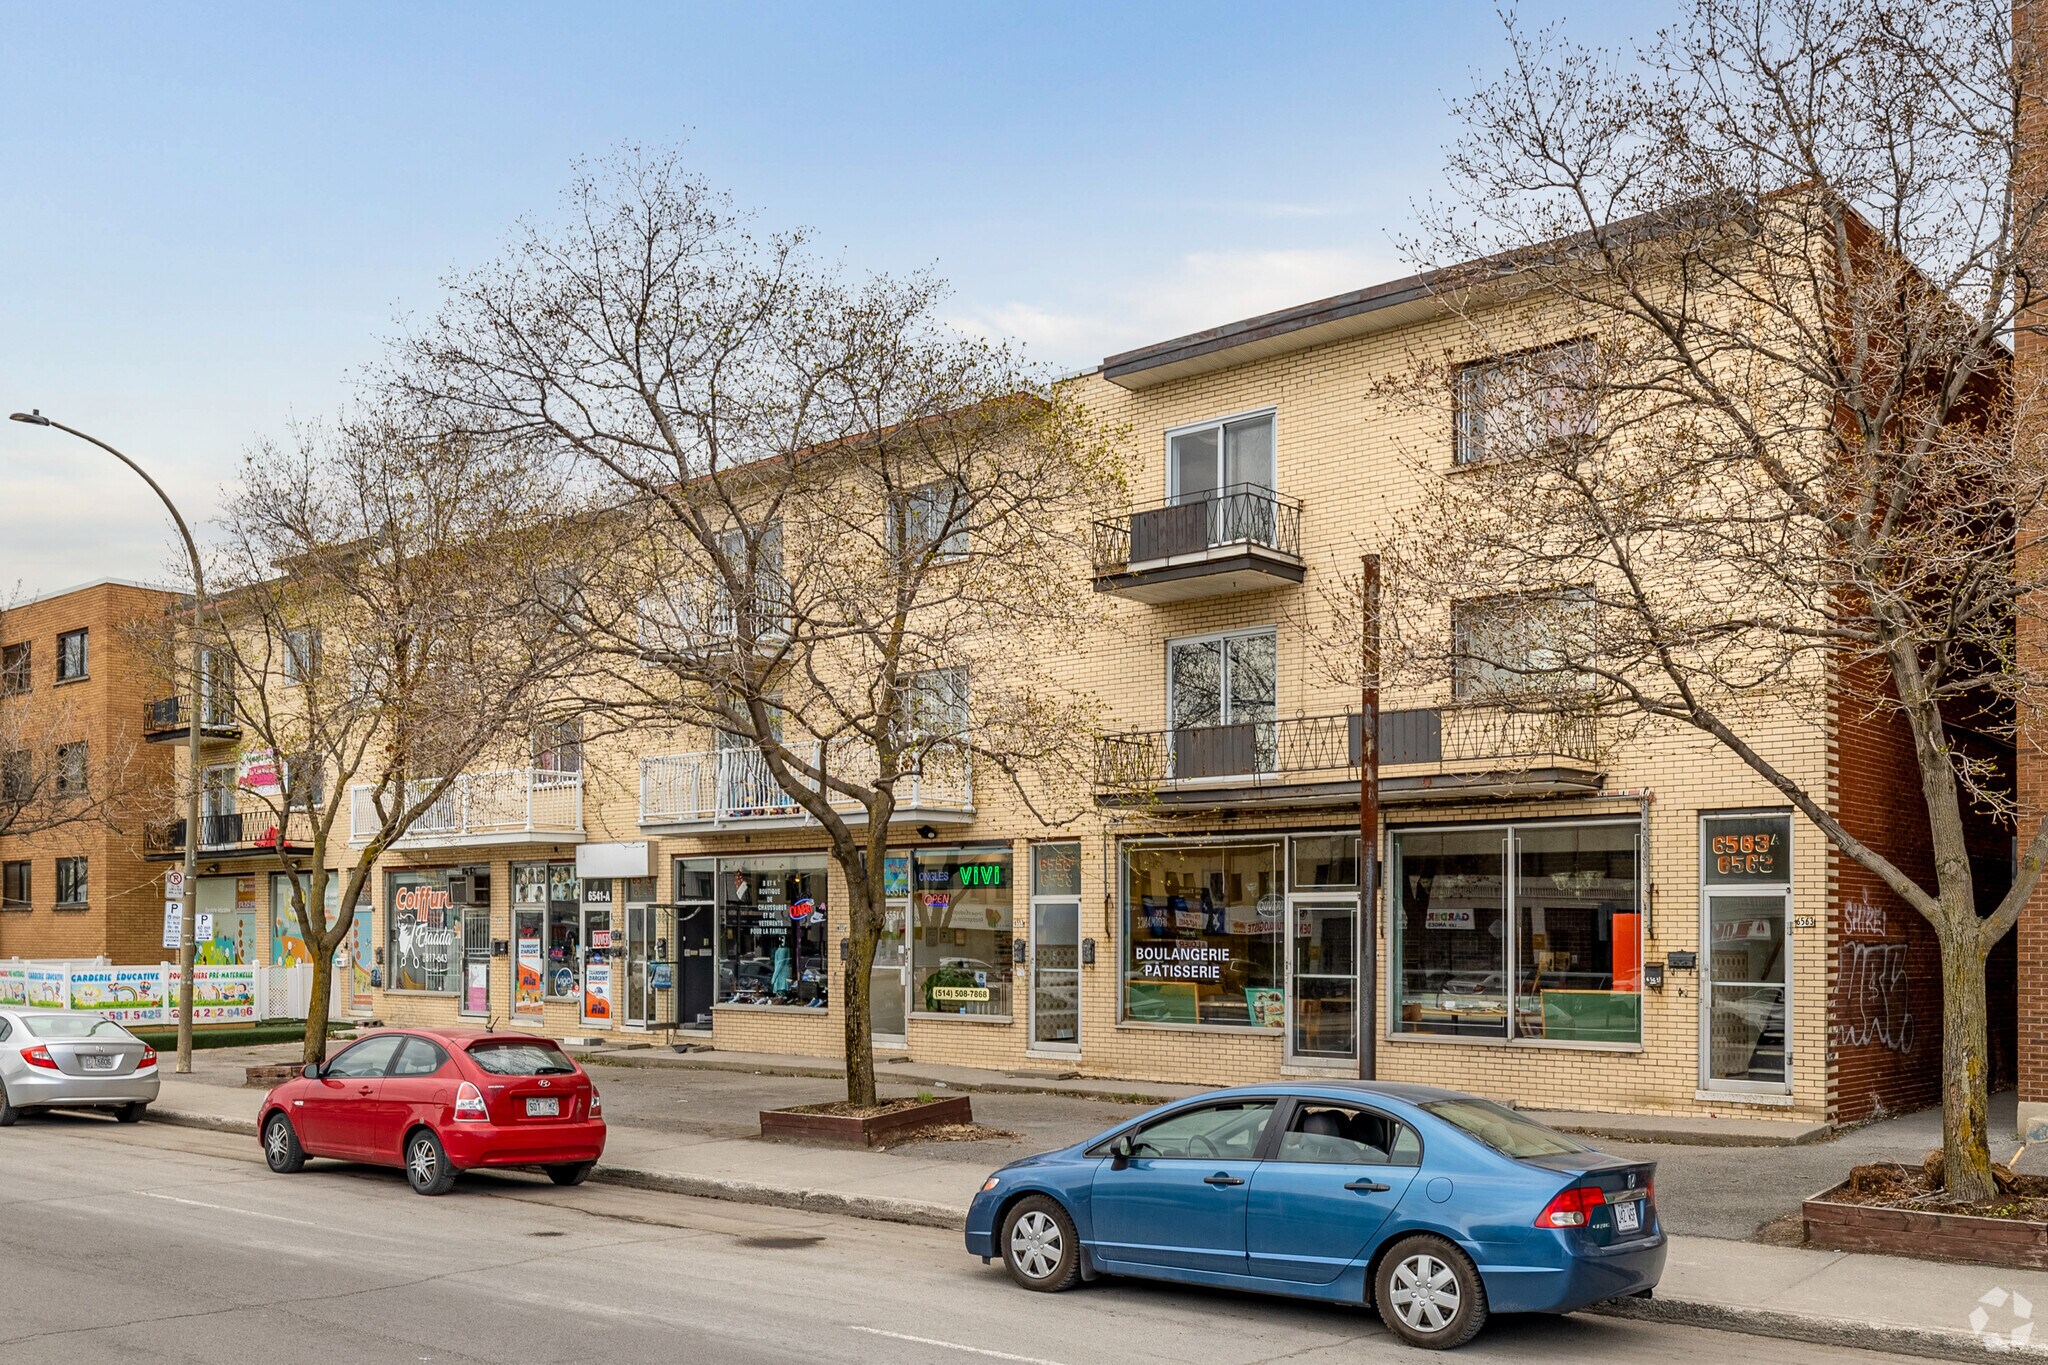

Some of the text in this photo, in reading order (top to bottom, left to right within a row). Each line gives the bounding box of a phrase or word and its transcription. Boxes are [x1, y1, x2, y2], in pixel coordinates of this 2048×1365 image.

[1717, 854, 1774, 875] 6563
[918, 871, 949, 882] ONGLES
[588, 890, 611, 902] 6541-A
[923, 893, 950, 906] OPEN
[171, 903, 179, 914] P
[201, 914, 208, 925] P
[1796, 917, 1814, 926] 6563
[1135, 947, 1230, 961] BOULANGERIE
[71, 970, 160, 983] GARDERIE ÉDUCATIVE
[1144, 961, 1220, 979] PÂTISSERIE
[523, 972, 537, 986] Ria
[934, 989, 988, 999] (514) 508-7868
[592, 1001, 605, 1014] Ria
